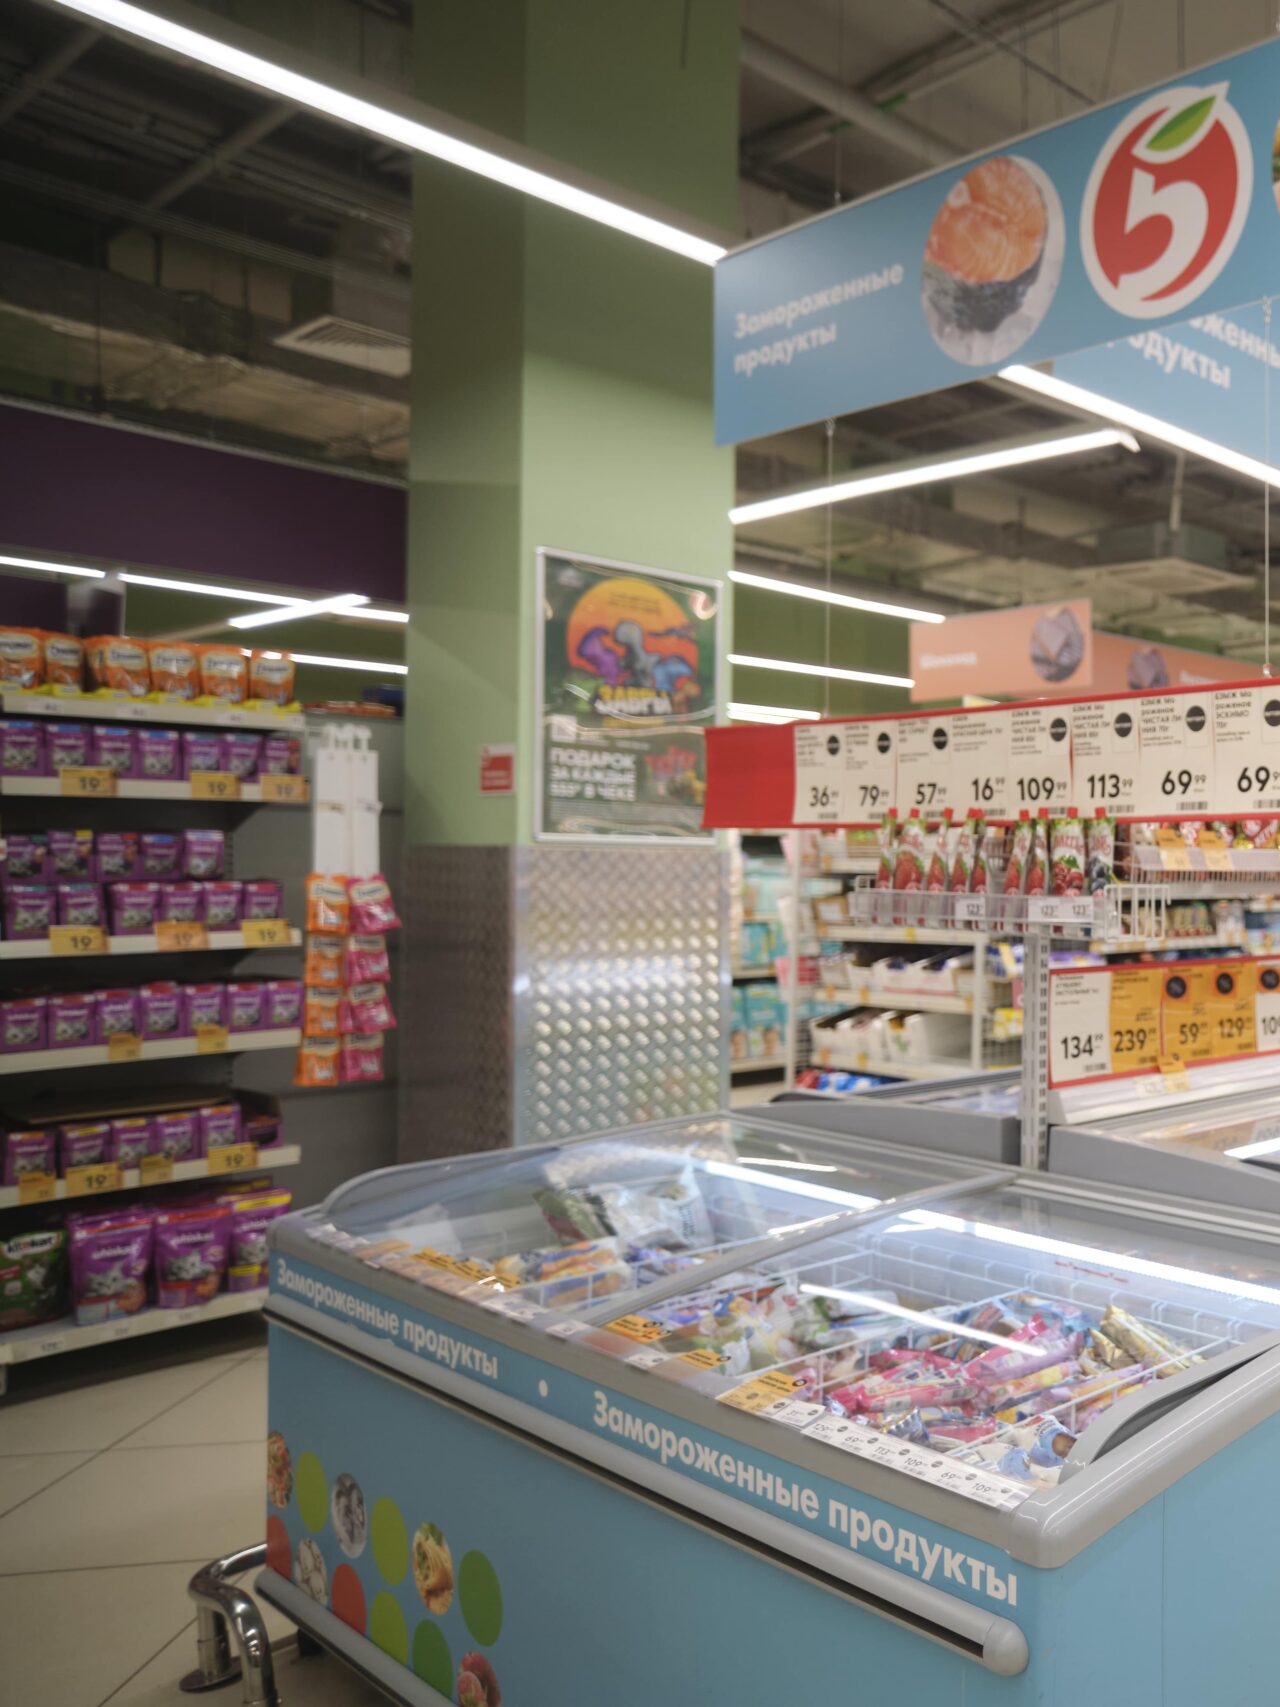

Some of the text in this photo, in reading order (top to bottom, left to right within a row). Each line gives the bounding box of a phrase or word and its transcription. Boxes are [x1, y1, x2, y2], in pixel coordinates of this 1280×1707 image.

[735, 262, 904, 339] Замороженные
[734, 323, 837, 377] продукты
[971, 777, 994, 801] 16
[1017, 777, 1054, 801] 109
[1087, 774, 1120, 798] 113
[1161, 770, 1192, 795] 69
[1237, 766, 1270, 792] 69
[810, 786, 829, 807] 36
[859, 785, 880, 807] 79
[915, 783, 937, 804] 57
[1179, 1022, 1199, 1044] 59
[1218, 1017, 1244, 1039] 129
[1061, 1034, 1093, 1059] 134
[1114, 1028, 1147, 1053] 239
[277, 1257, 498, 1380] Замороженные продукты
[592, 1391, 1018, 1606] Замороженные продукты
